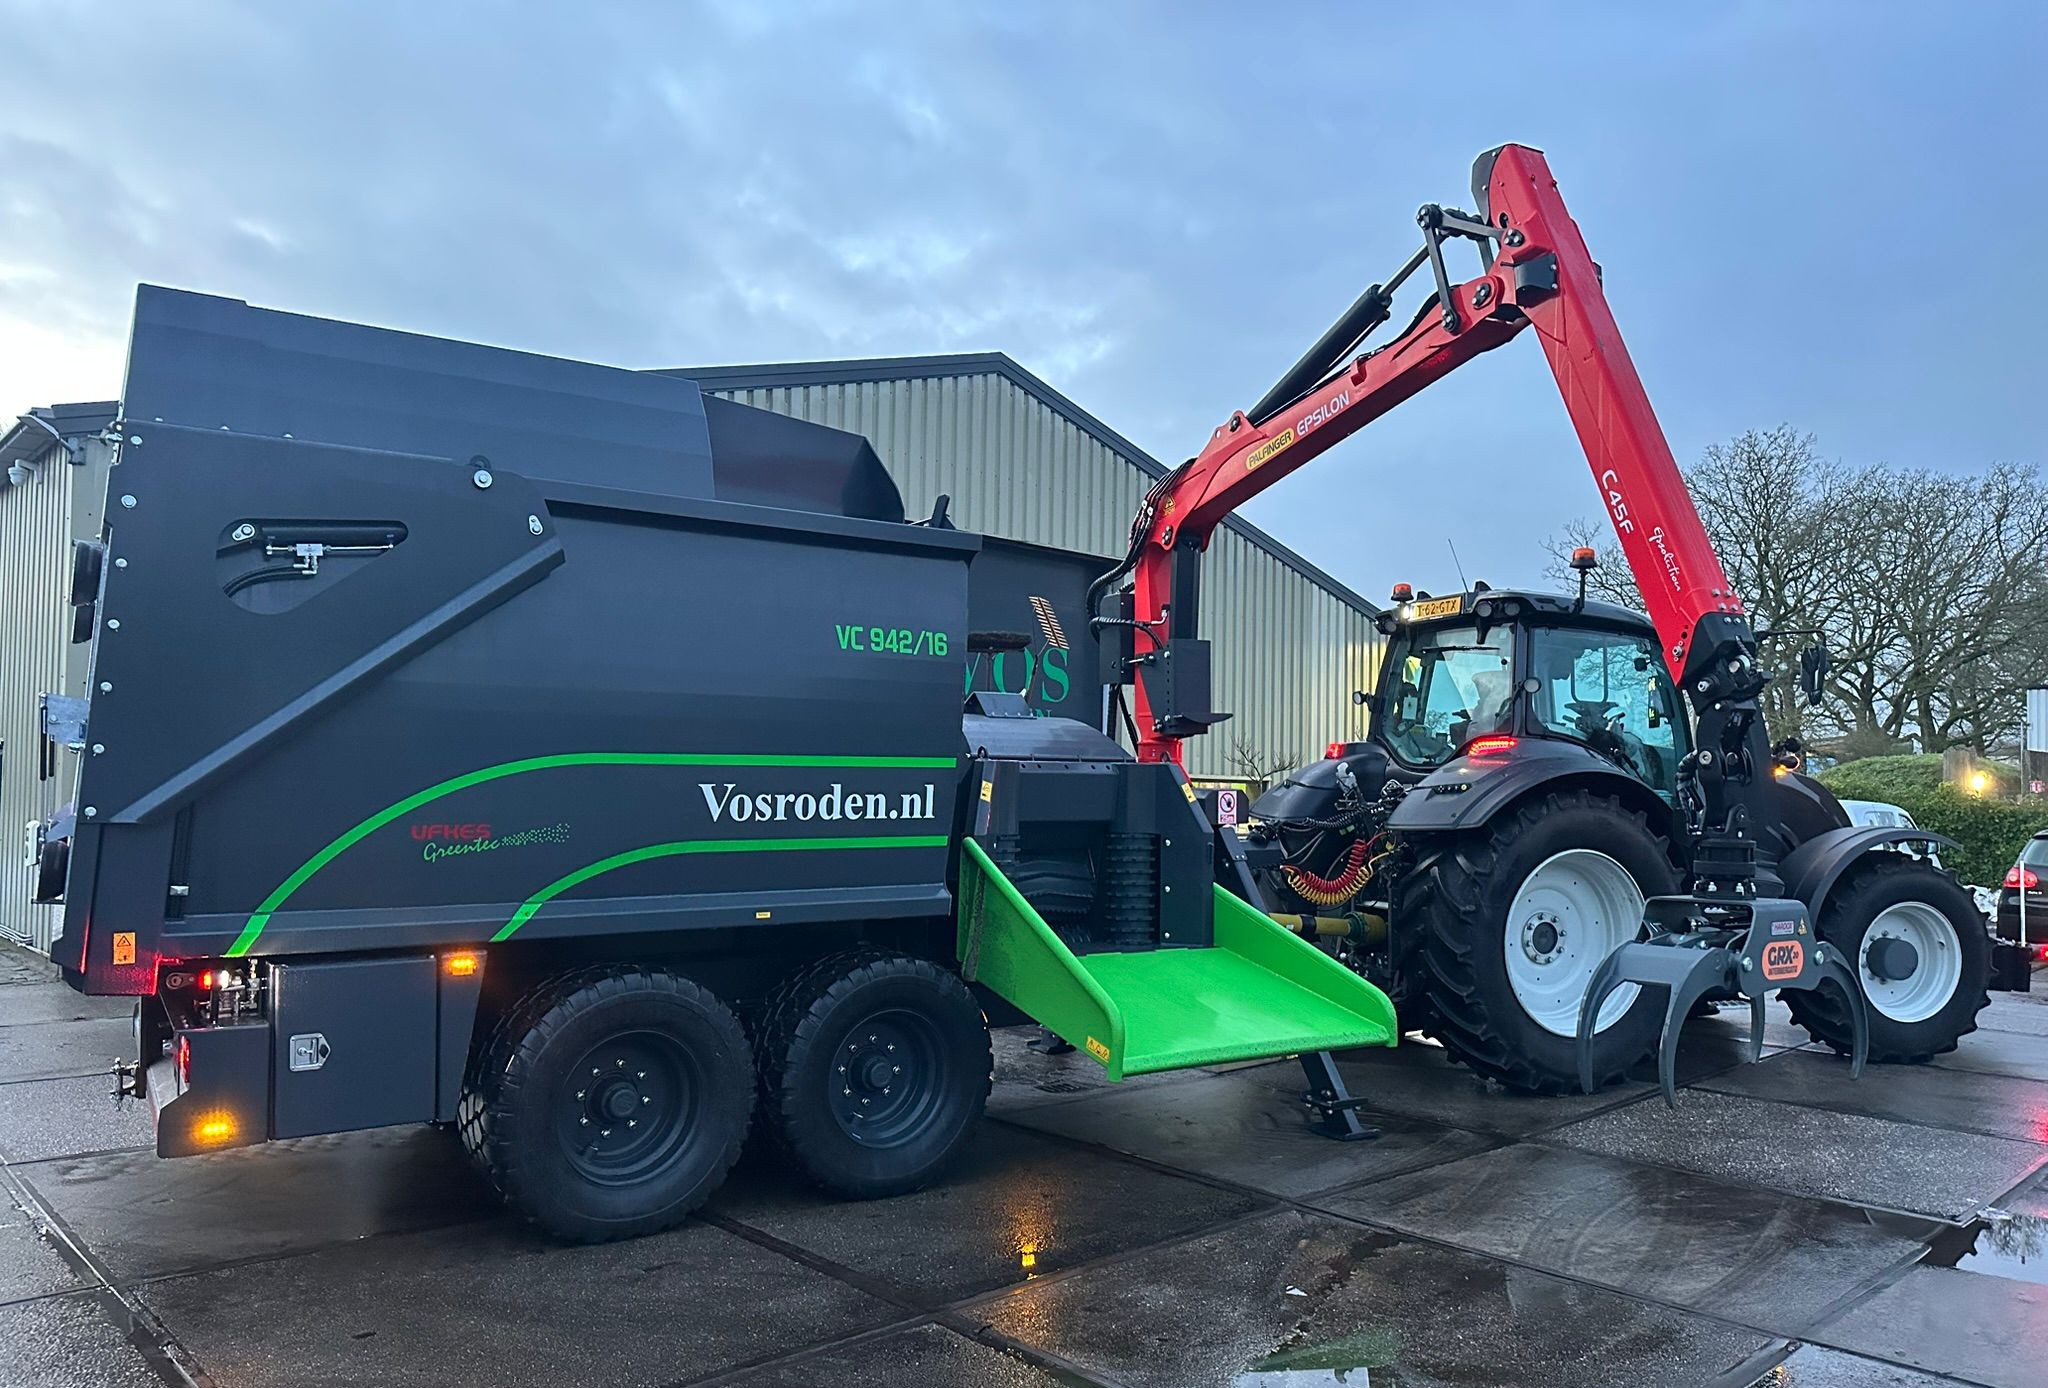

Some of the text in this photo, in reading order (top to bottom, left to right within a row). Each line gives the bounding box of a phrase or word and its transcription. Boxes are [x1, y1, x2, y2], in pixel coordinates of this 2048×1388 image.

[1248, 390, 1350, 467] PALFINGER EPSILON
[1648, 526, 1681, 592] Epsolution
[835, 624, 948, 656] VC 942/16
[698, 783, 936, 823] Vosroden.nl
[423, 837, 500, 862] Greentec
[1768, 945, 1795, 966] GRX
